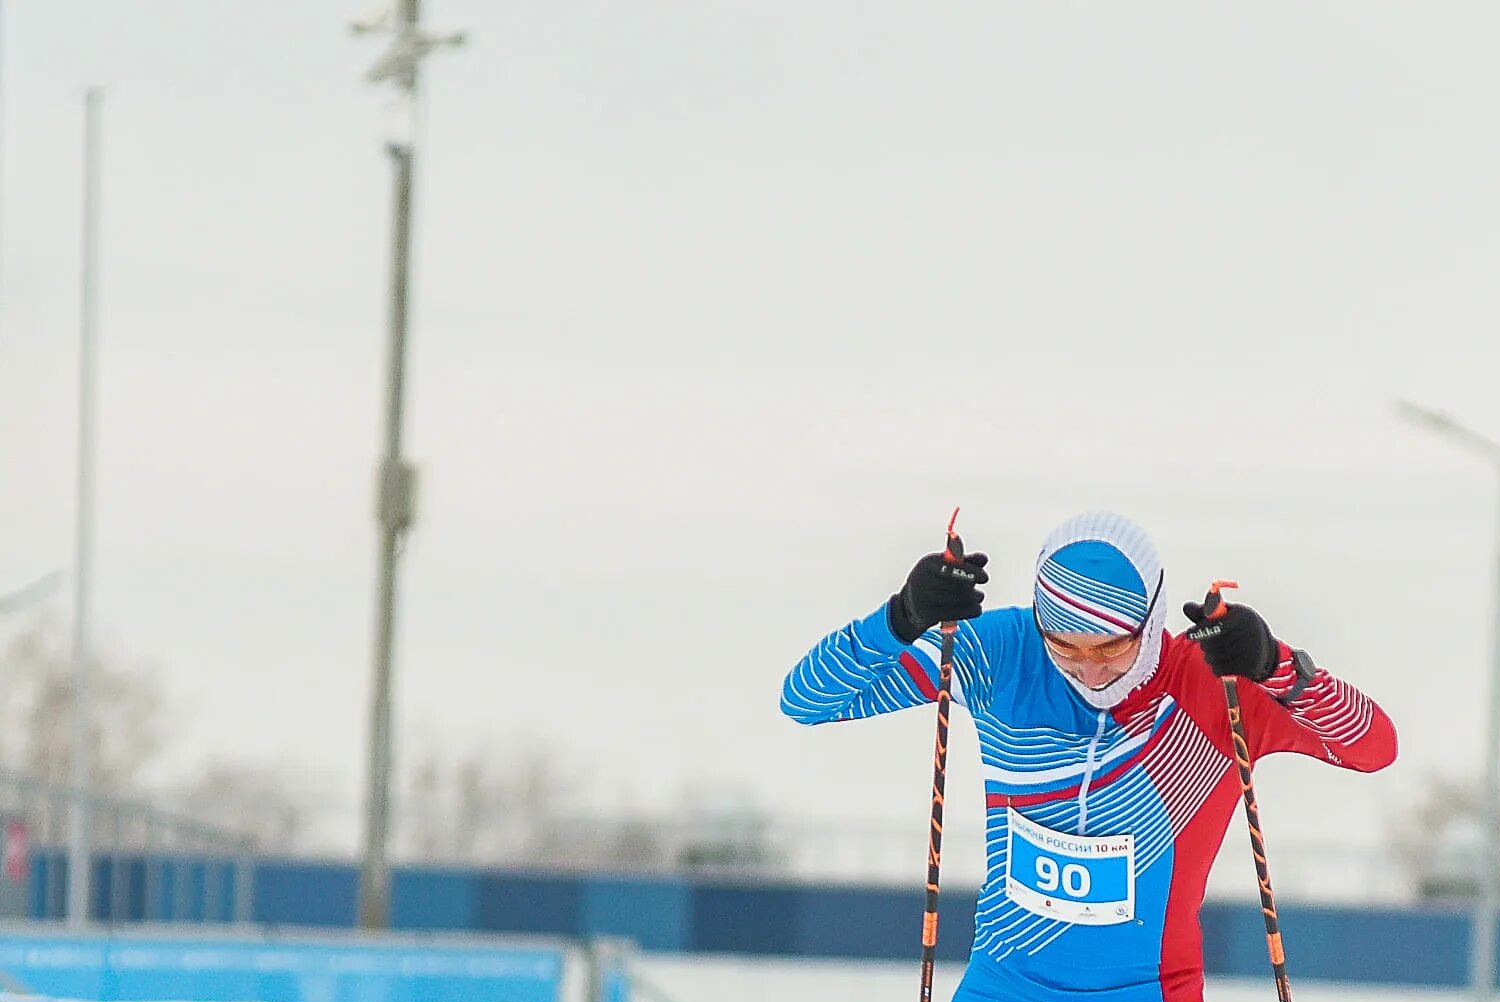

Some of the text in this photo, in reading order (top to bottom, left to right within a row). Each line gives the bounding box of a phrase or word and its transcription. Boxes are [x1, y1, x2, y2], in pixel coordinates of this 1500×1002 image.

[941, 565, 975, 579] rkka
[1189, 625, 1222, 639] rukka
[1046, 837, 1092, 853] РОССИИ
[1095, 844, 1108, 853] 10
[1035, 856, 1091, 898] 90
